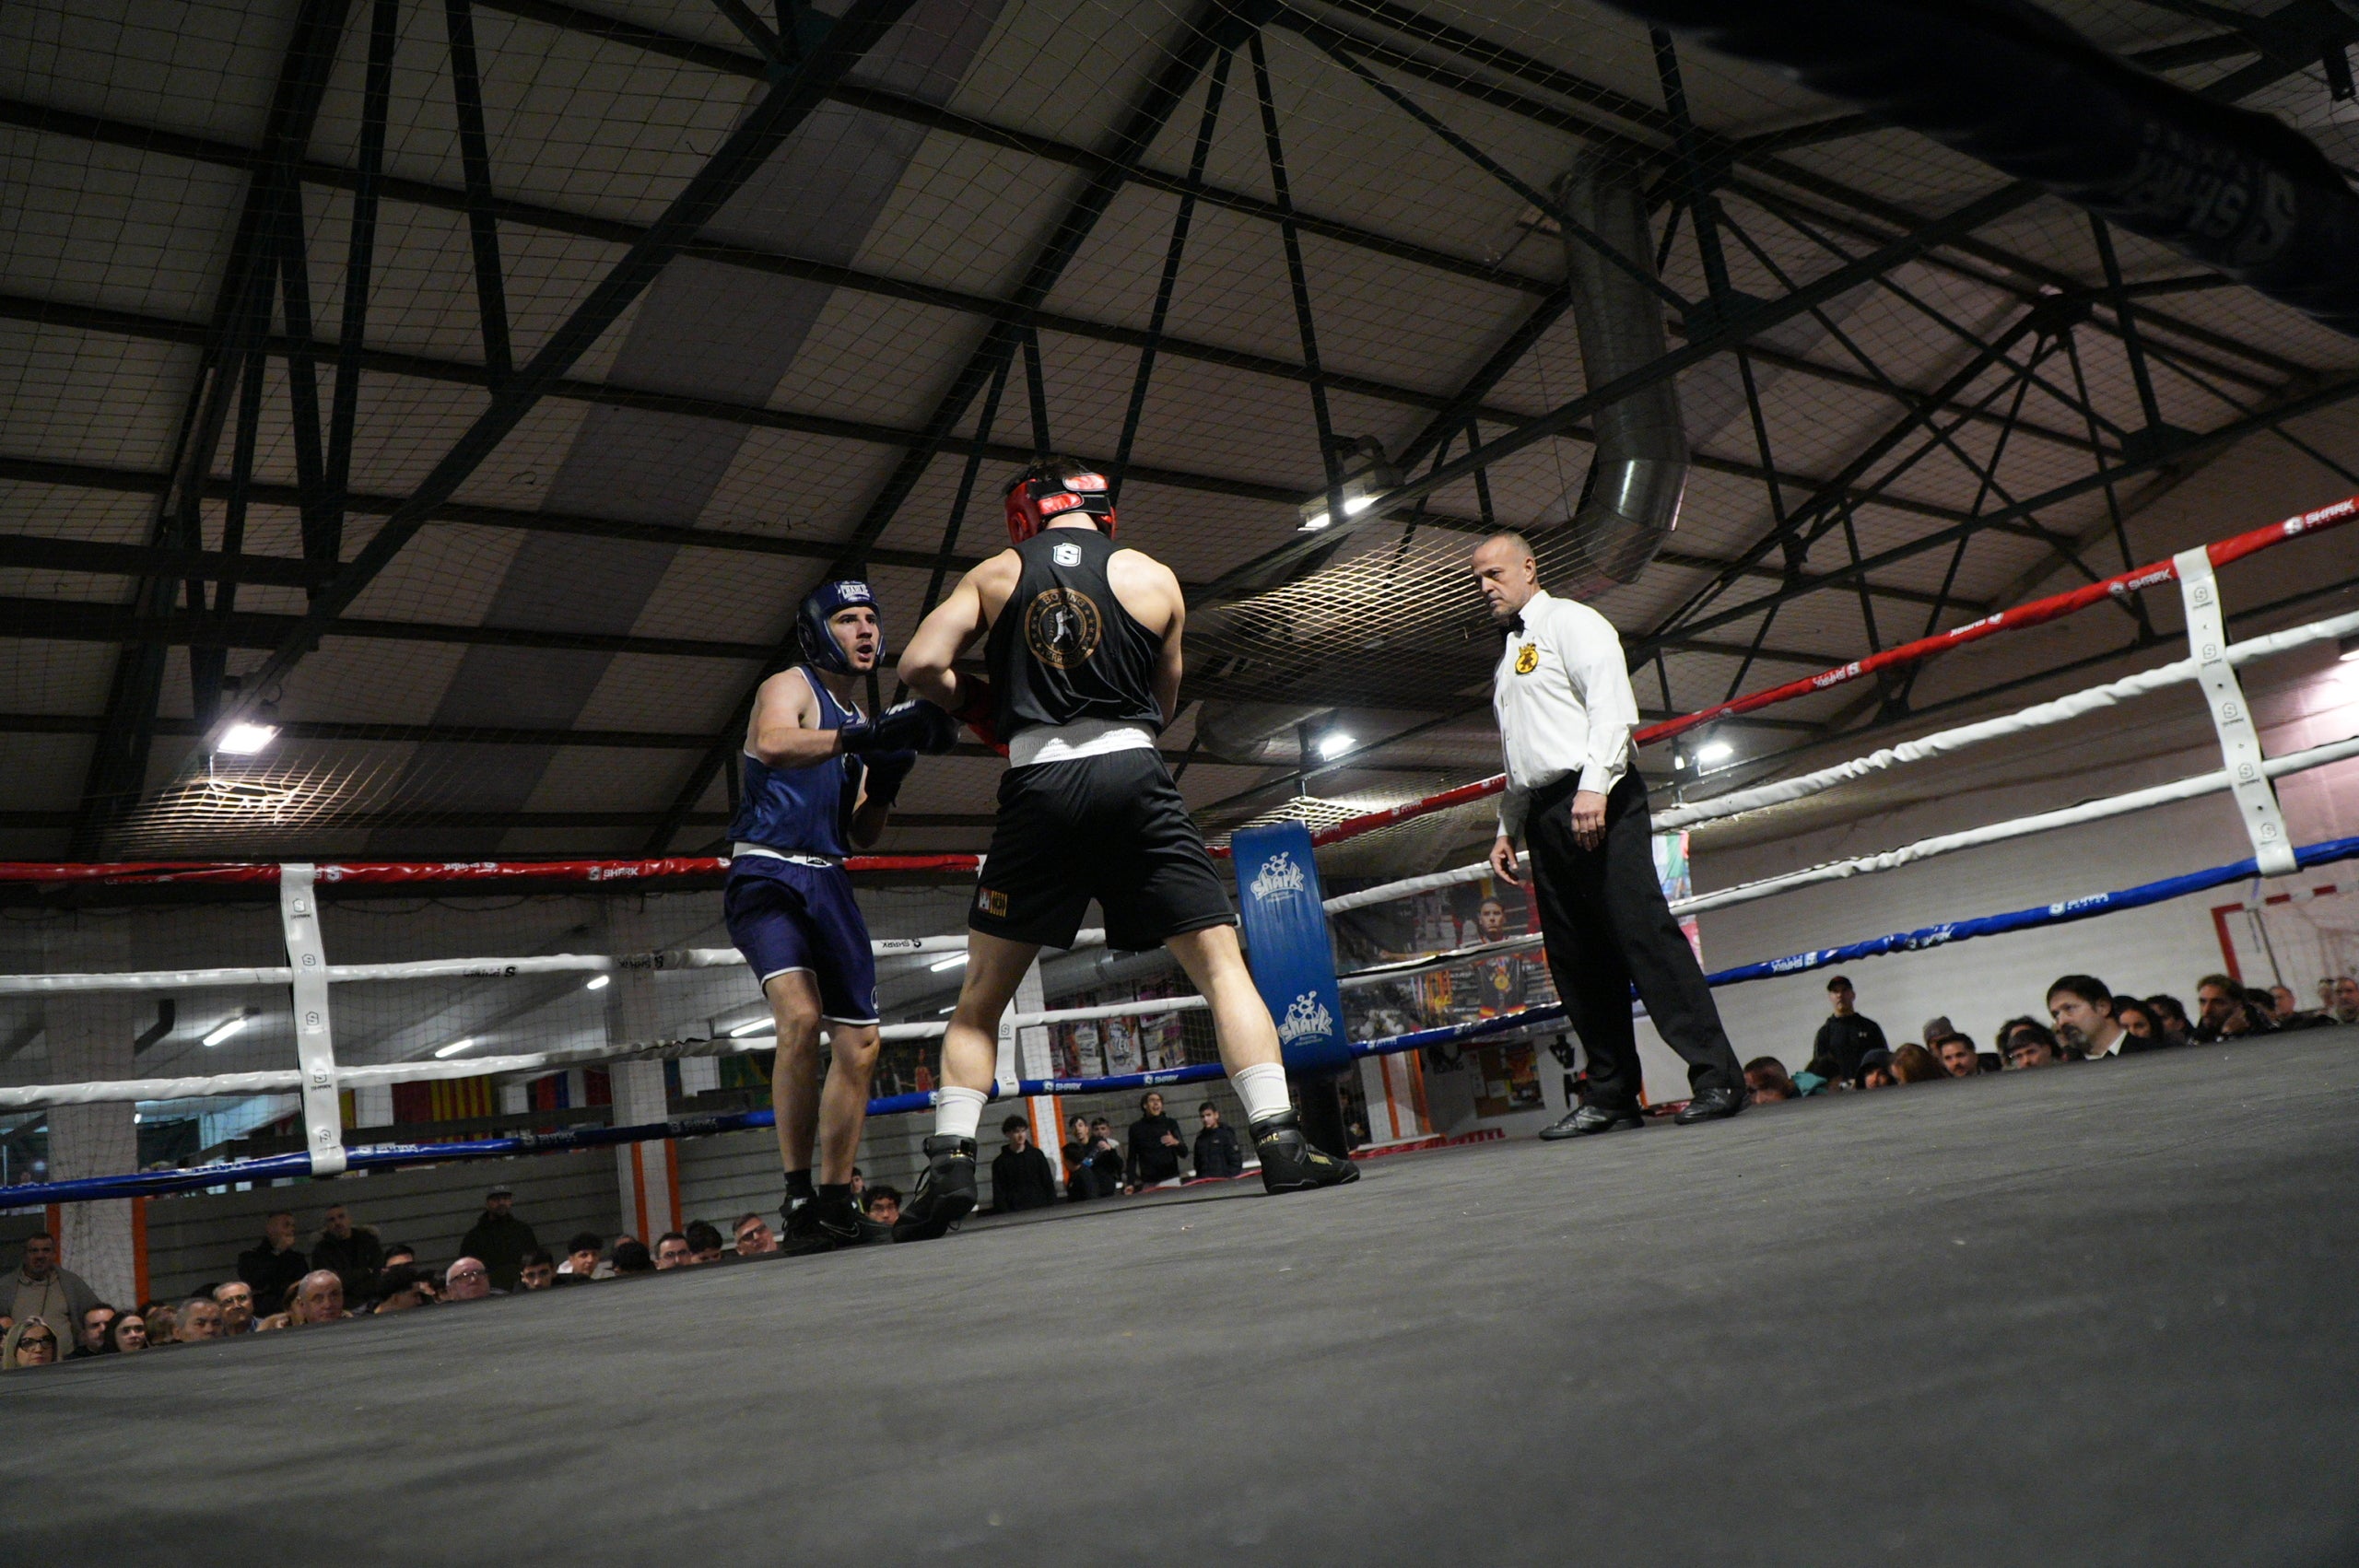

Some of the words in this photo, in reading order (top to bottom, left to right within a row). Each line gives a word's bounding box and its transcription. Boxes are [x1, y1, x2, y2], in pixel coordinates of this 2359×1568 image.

[2306, 498, 2353, 524] SHARK
[2128, 568, 2172, 591] SHARK
[1042, 592, 1086, 607] BOING
[604, 867, 639, 877] SHARK
